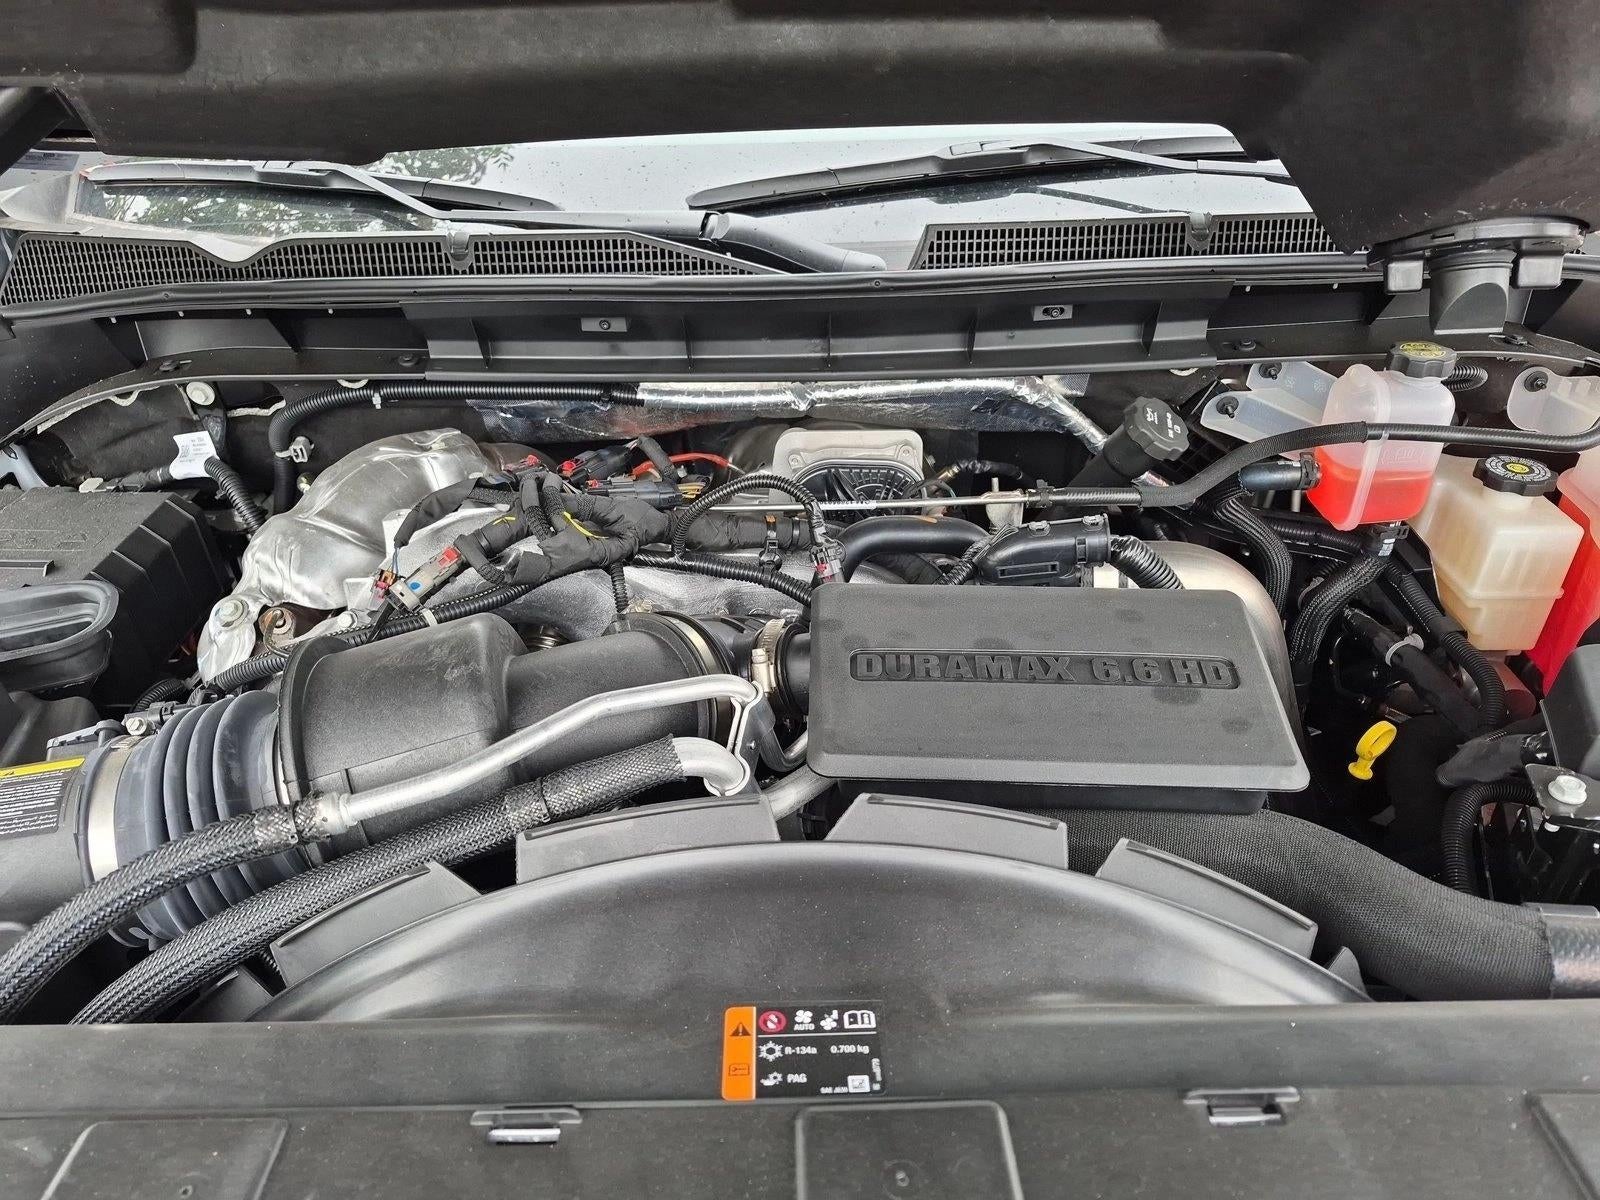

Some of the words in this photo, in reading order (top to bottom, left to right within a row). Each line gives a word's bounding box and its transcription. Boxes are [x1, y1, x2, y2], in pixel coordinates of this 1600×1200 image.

[855, 653, 1077, 682] DURAMAX
[1091, 657, 1163, 684] 6.6
[1171, 659, 1236, 686] HD
[794, 1023, 815, 1031] AUTO
[785, 1045, 818, 1055] R-134a
[857, 1044, 870, 1055] kg
[787, 1073, 808, 1084] PAG
